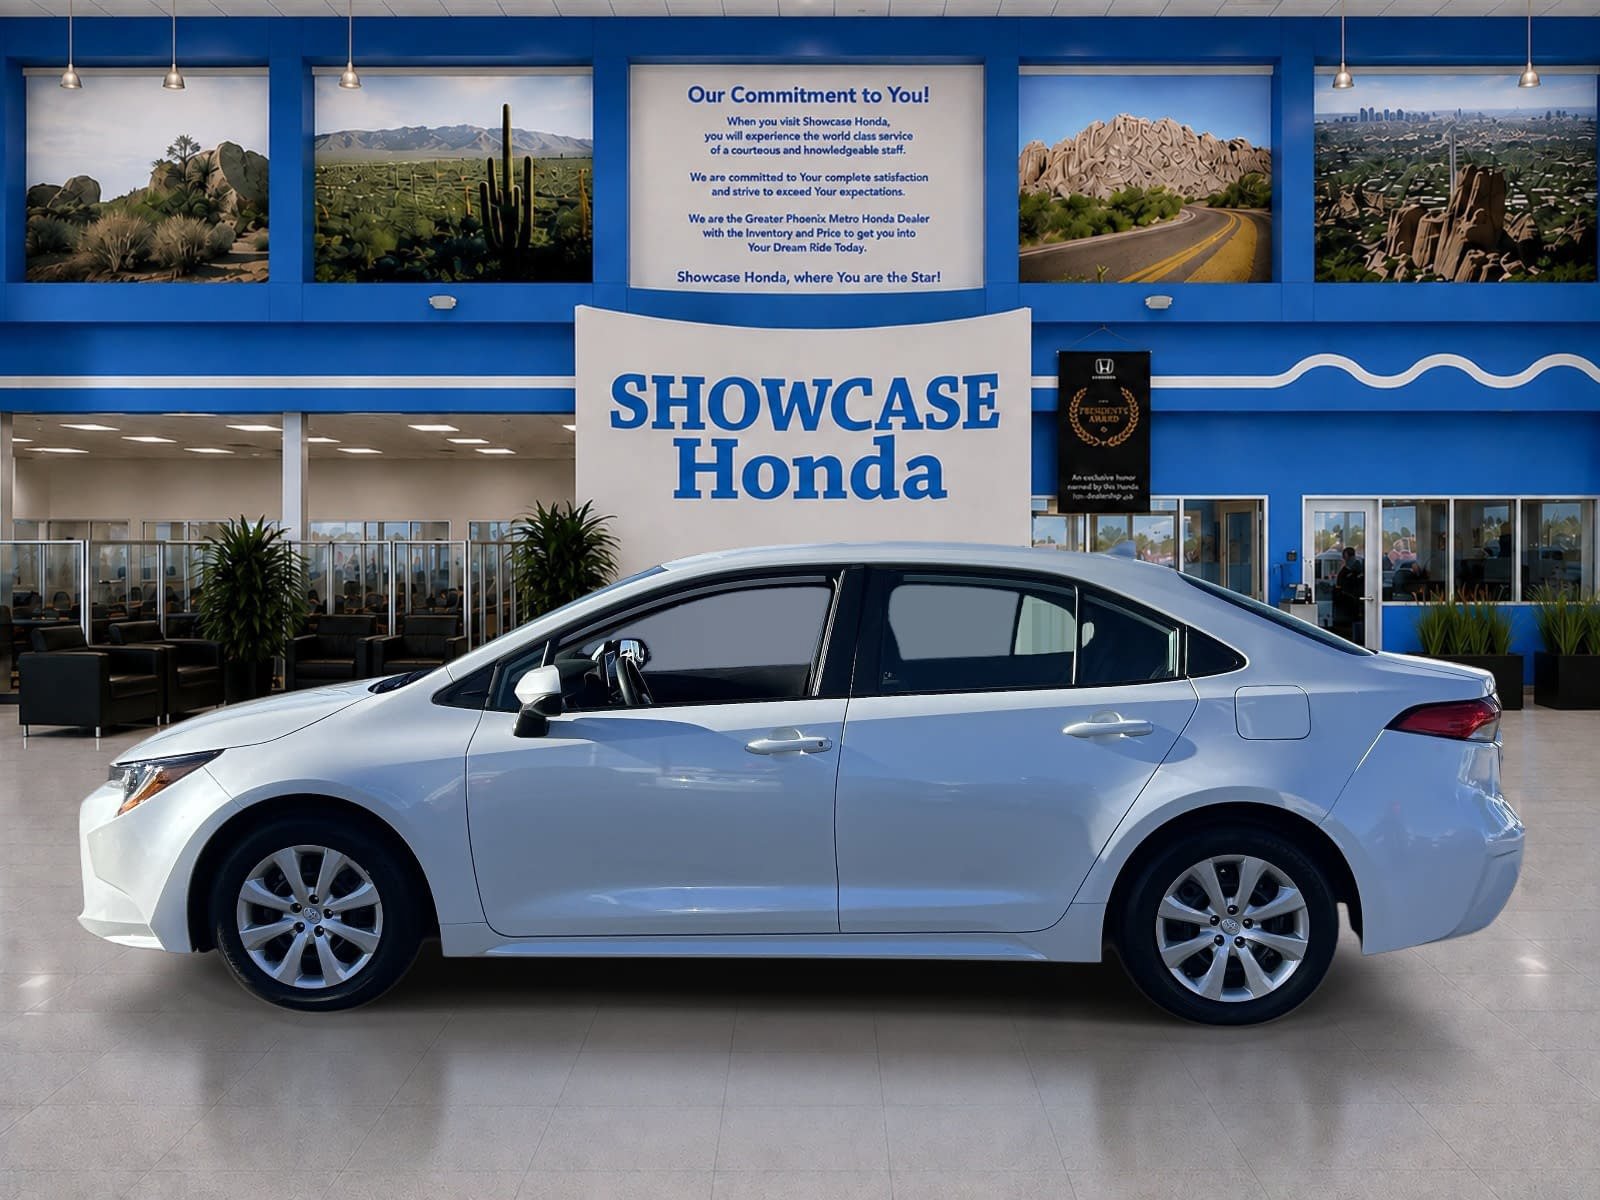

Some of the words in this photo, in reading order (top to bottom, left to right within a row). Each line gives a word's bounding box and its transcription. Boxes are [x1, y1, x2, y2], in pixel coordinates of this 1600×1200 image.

[687, 85, 726, 104] Our
[730, 85, 857, 104] Commitment
[861, 87, 883, 104] to
[886, 85, 930, 104] You!
[726, 116, 757, 127] When
[758, 118, 778, 129] you
[779, 116, 801, 127] visit
[802, 115, 853, 127] Showcase
[854, 116, 891, 128] Honda,
[704, 133, 724, 144] you
[725, 130, 743, 141] will
[745, 130, 801, 144] experience
[802, 130, 820, 141] the
[821, 130, 851, 141] world
[852, 130, 877, 141] class
[878, 130, 914, 142] service
[710, 144, 721, 155] of
[722, 147, 730, 155] a
[730, 146, 781, 156] courteous
[782, 144, 802, 155] and
[881, 144, 906, 155] staff.
[689, 172, 708, 183] We
[709, 174, 726, 182] are
[728, 172, 784, 183] committed
[785, 173, 798, 182] to
[799, 172, 823, 183] Your
[824, 172, 872, 185] complete
[873, 171, 929, 183] satisfaction
[711, 186, 731, 197] and
[732, 186, 761, 197] strive
[762, 187, 774, 197] to
[775, 186, 812, 197] exceed
[814, 186, 838, 197] Your
[839, 186, 906, 200] expectations.
[688, 213, 706, 224] We
[707, 216, 725, 224] are
[725, 213, 743, 224] the
[744, 213, 785, 224] Greater
[786, 213, 827, 224] Phoenix
[828, 213, 860, 224] Metro
[861, 213, 895, 224] Honda
[897, 213, 931, 224] Dealer
[702, 227, 725, 238] with
[726, 227, 744, 238] the
[745, 227, 794, 241] Inventory
[795, 227, 815, 239] and
[816, 227, 842, 238] Price
[843, 229, 855, 238] to
[856, 229, 875, 241] get
[876, 230, 895, 241] you
[896, 227, 917, 238] into
[747, 242, 772, 253] Your
[773, 242, 807, 253] Dream
[809, 242, 833, 253] Ride
[833, 242, 867, 255] Today.
[677, 270, 741, 283] Showcase
[744, 270, 790, 286] Honda,
[793, 270, 834, 284] where
[836, 271, 861, 284] You
[863, 274, 884, 284] are
[886, 270, 908, 284] the
[911, 271, 941, 284] Star!
[610, 372, 1000, 432] SHOWCASE
[672, 434, 948, 500] Honda
